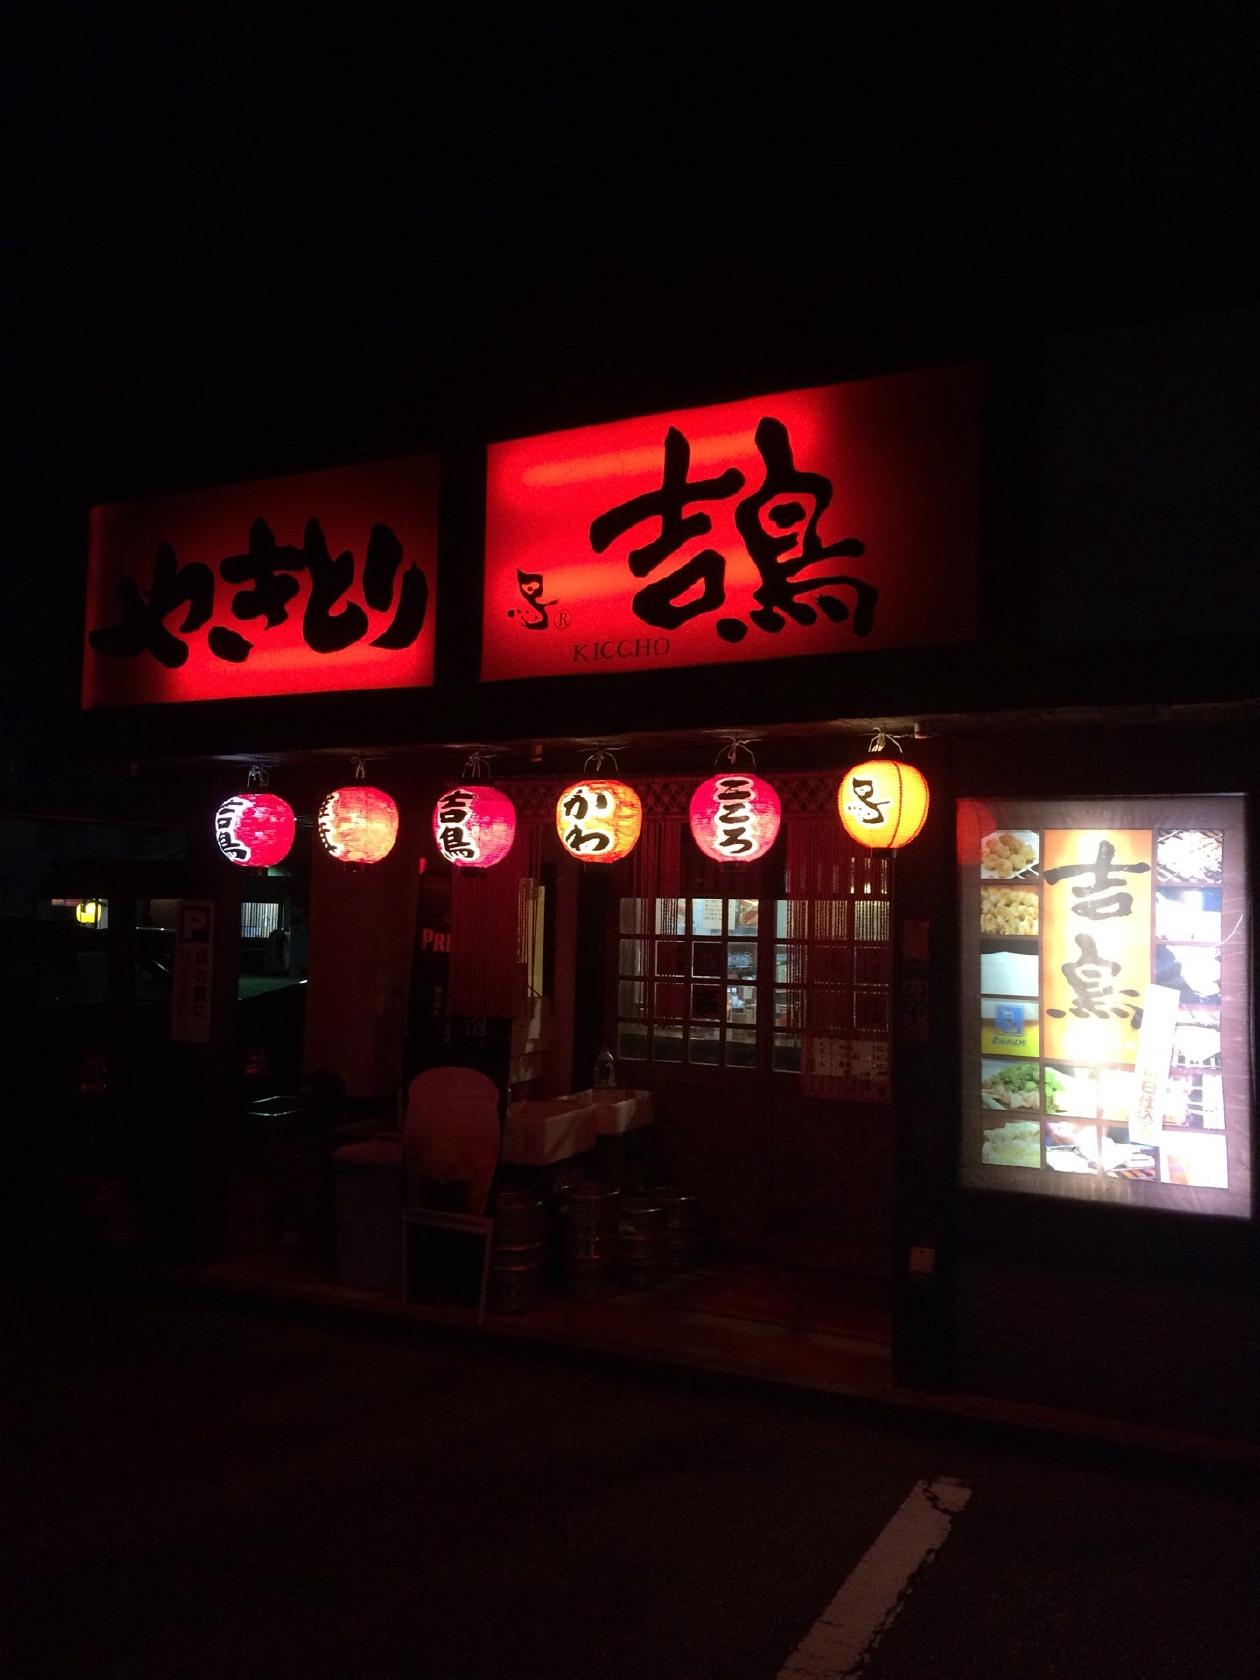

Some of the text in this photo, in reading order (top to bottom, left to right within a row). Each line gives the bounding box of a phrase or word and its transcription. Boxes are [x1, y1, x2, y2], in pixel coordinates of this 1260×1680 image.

[89, 516, 428, 669] やきとり
[572, 638, 670, 662] KICCHO
[440, 789, 475, 861] 吉鳥
[563, 788, 611, 852] かわ
[719, 779, 753, 855] こころ
[183, 910, 208, 941] P
[1043, 839, 1151, 1030] 吉鳥
